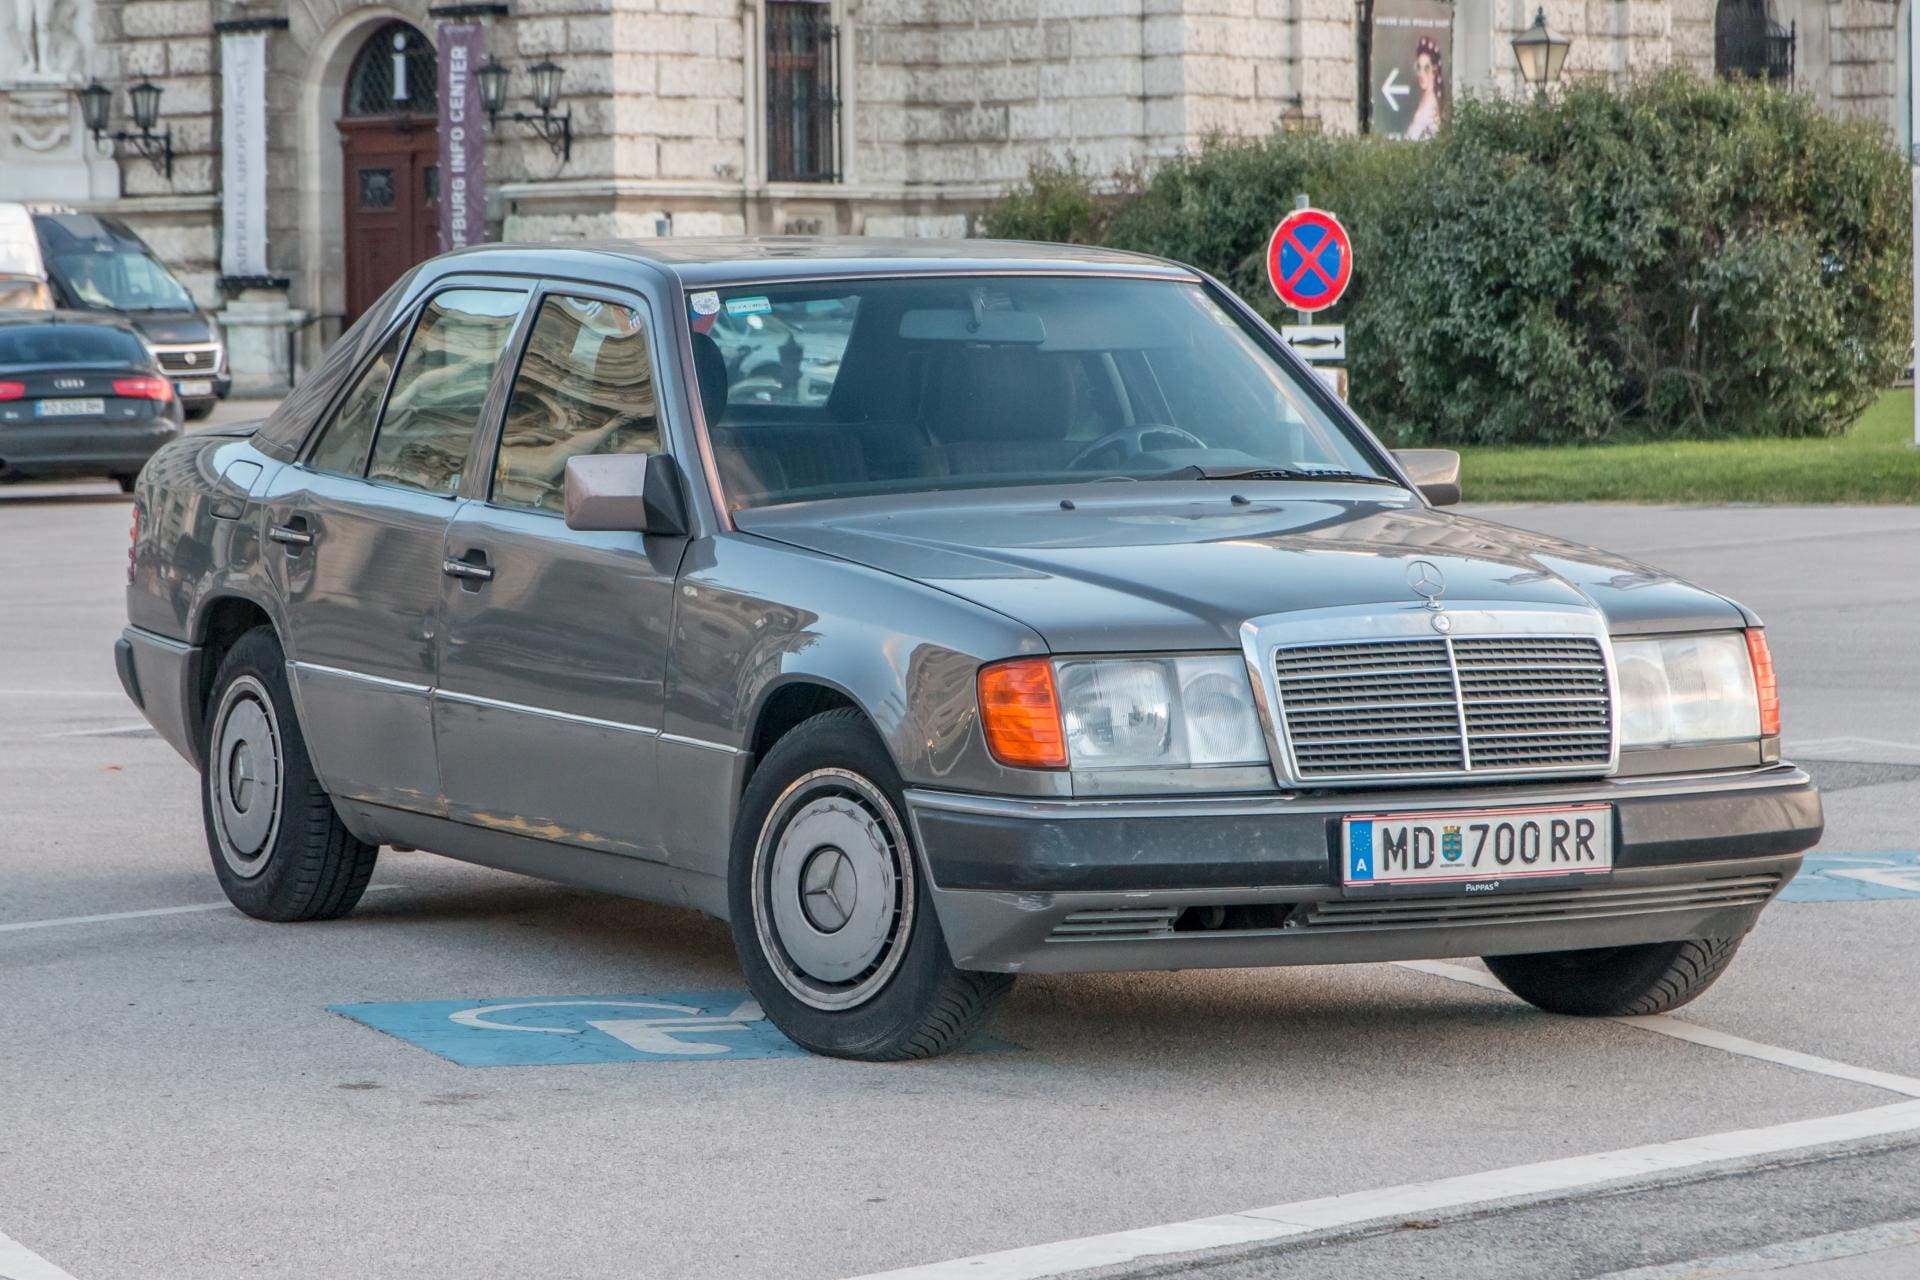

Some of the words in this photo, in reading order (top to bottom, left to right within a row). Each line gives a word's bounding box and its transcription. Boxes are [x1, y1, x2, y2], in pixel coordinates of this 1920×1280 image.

[392, 33, 408, 100] i
[449, 46, 468, 123] CENTER
[450, 126, 465, 173] INFO
[1356, 858, 1367, 872] A
[1382, 826, 1435, 872] MD
[1469, 820, 1541, 868] 700
[1551, 818, 1595, 862] RR
